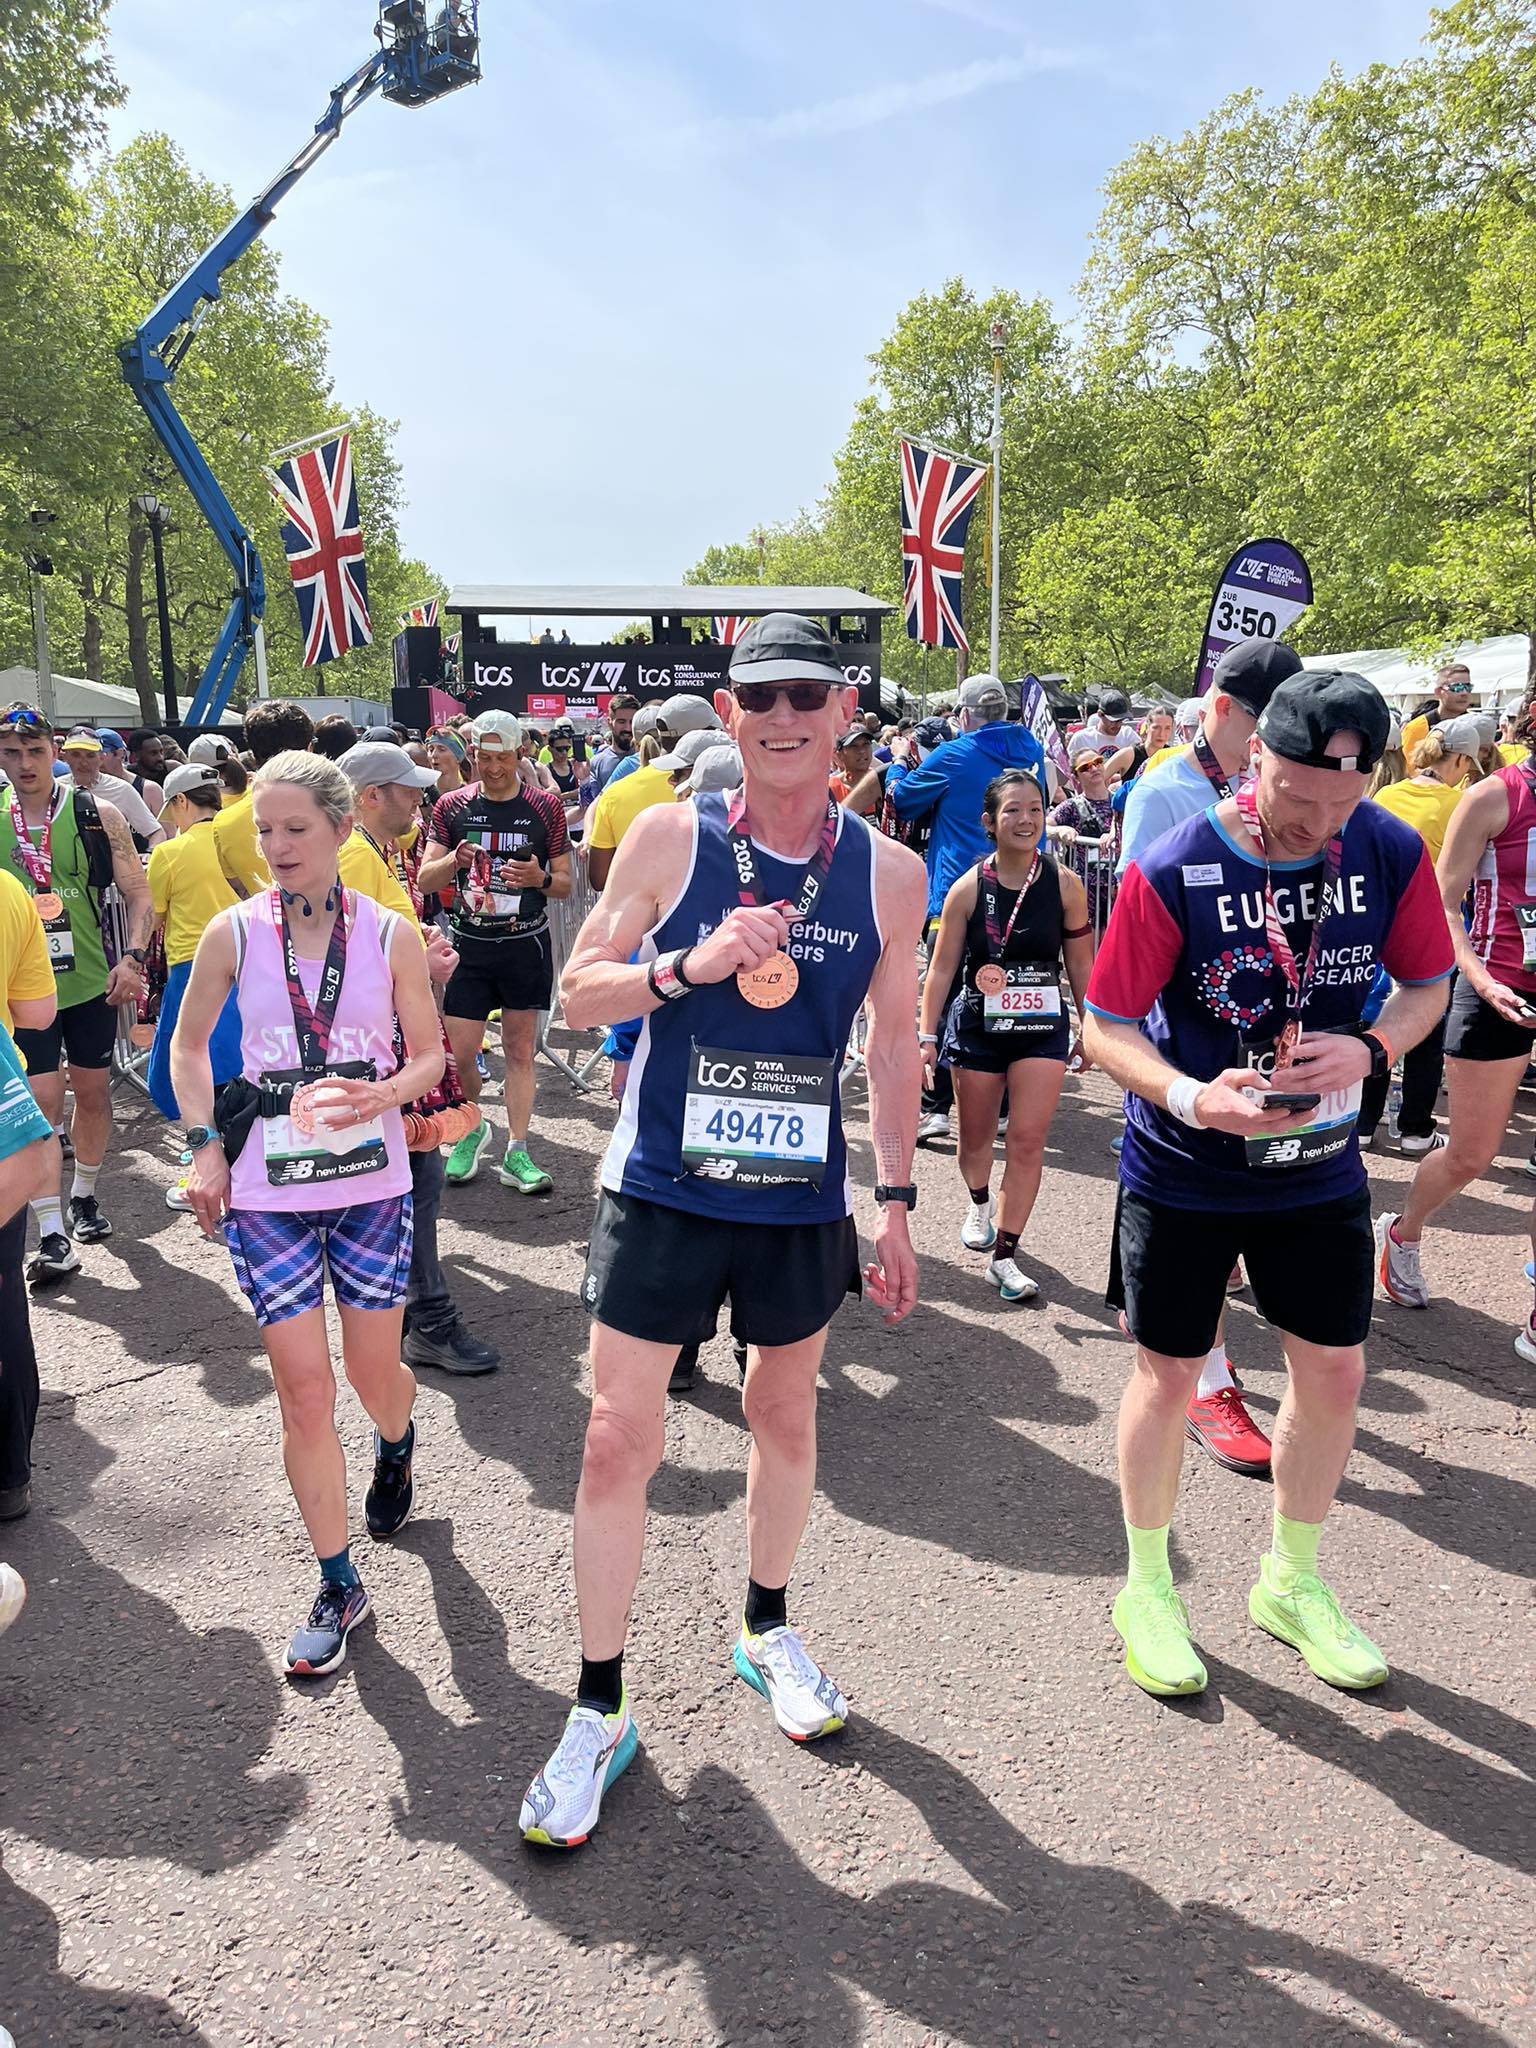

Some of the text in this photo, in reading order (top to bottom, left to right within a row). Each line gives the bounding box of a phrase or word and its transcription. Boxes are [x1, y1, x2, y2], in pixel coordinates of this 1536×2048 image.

[1268, 571, 1302, 584] MARATHON
[1269, 564, 1294, 575] LONDON
[1267, 576, 1289, 587] EVENTS
[1222, 591, 1238, 601] SUB
[1217, 601, 1277, 638] 3:50
[474, 661, 513, 686] tcs
[541, 661, 580, 687] tcs
[638, 664, 671, 686] tcs
[840, 665, 872, 685] cs
[674, 679, 704, 687] SERVICES
[733, 839, 755, 884] 2026
[1216, 875, 1367, 933] EUGENE
[786, 939, 825, 962] iers
[752, 974, 767, 983] tcs
[322, 985, 336, 1001] tcs
[1001, 993, 1044, 1010] 8255
[1286, 990, 1313, 1008] UK
[754, 1061, 784, 1072] TATA
[1247, 1050, 1277, 1075] tc
[697, 1055, 747, 1090] tcs
[752, 1071, 823, 1086] CONSULTANCY
[751, 1081, 796, 1094] SERVICES
[705, 1108, 804, 1148] 49478
[1303, 1148, 1323, 1158] new
[316, 1167, 337, 1177] new
[339, 1159, 378, 1173] balance
[737, 1173, 760, 1183] new
[763, 1174, 809, 1184] balance
